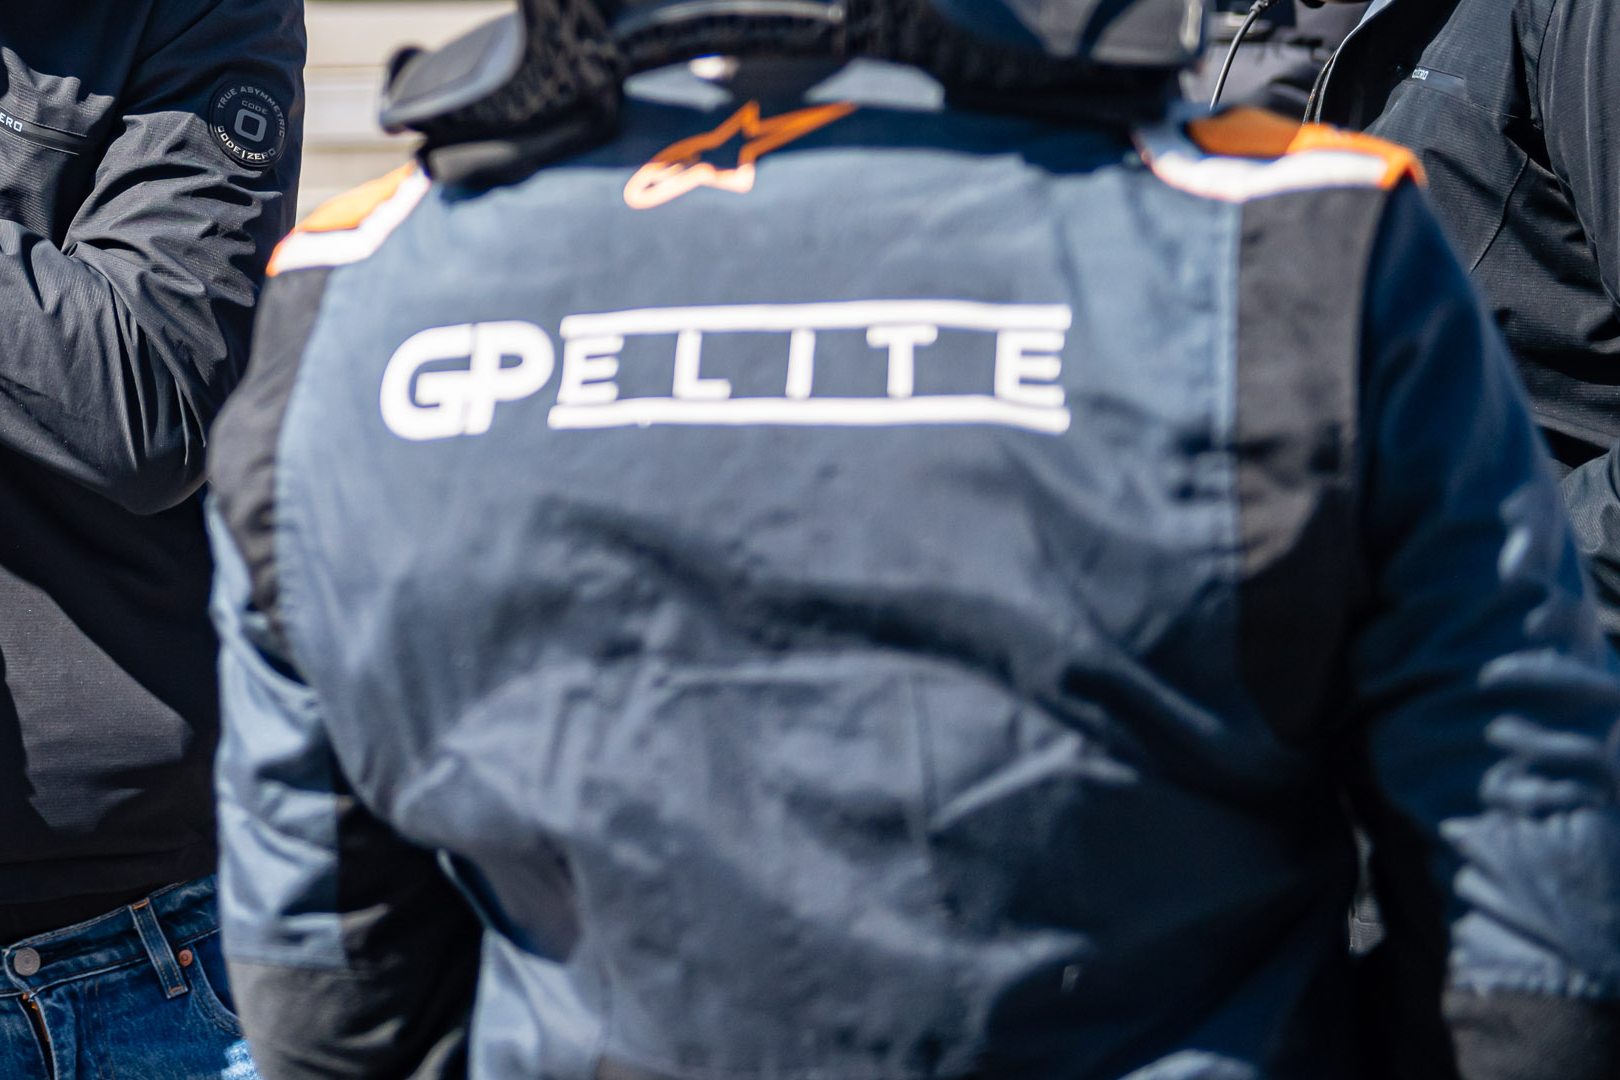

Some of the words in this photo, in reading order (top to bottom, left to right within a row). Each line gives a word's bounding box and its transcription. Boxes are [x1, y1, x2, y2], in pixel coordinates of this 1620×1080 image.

[217, 87, 238, 109] TRUE
[240, 86, 285, 138] ASYMMETRIC
[241, 100, 268, 114] CODE
